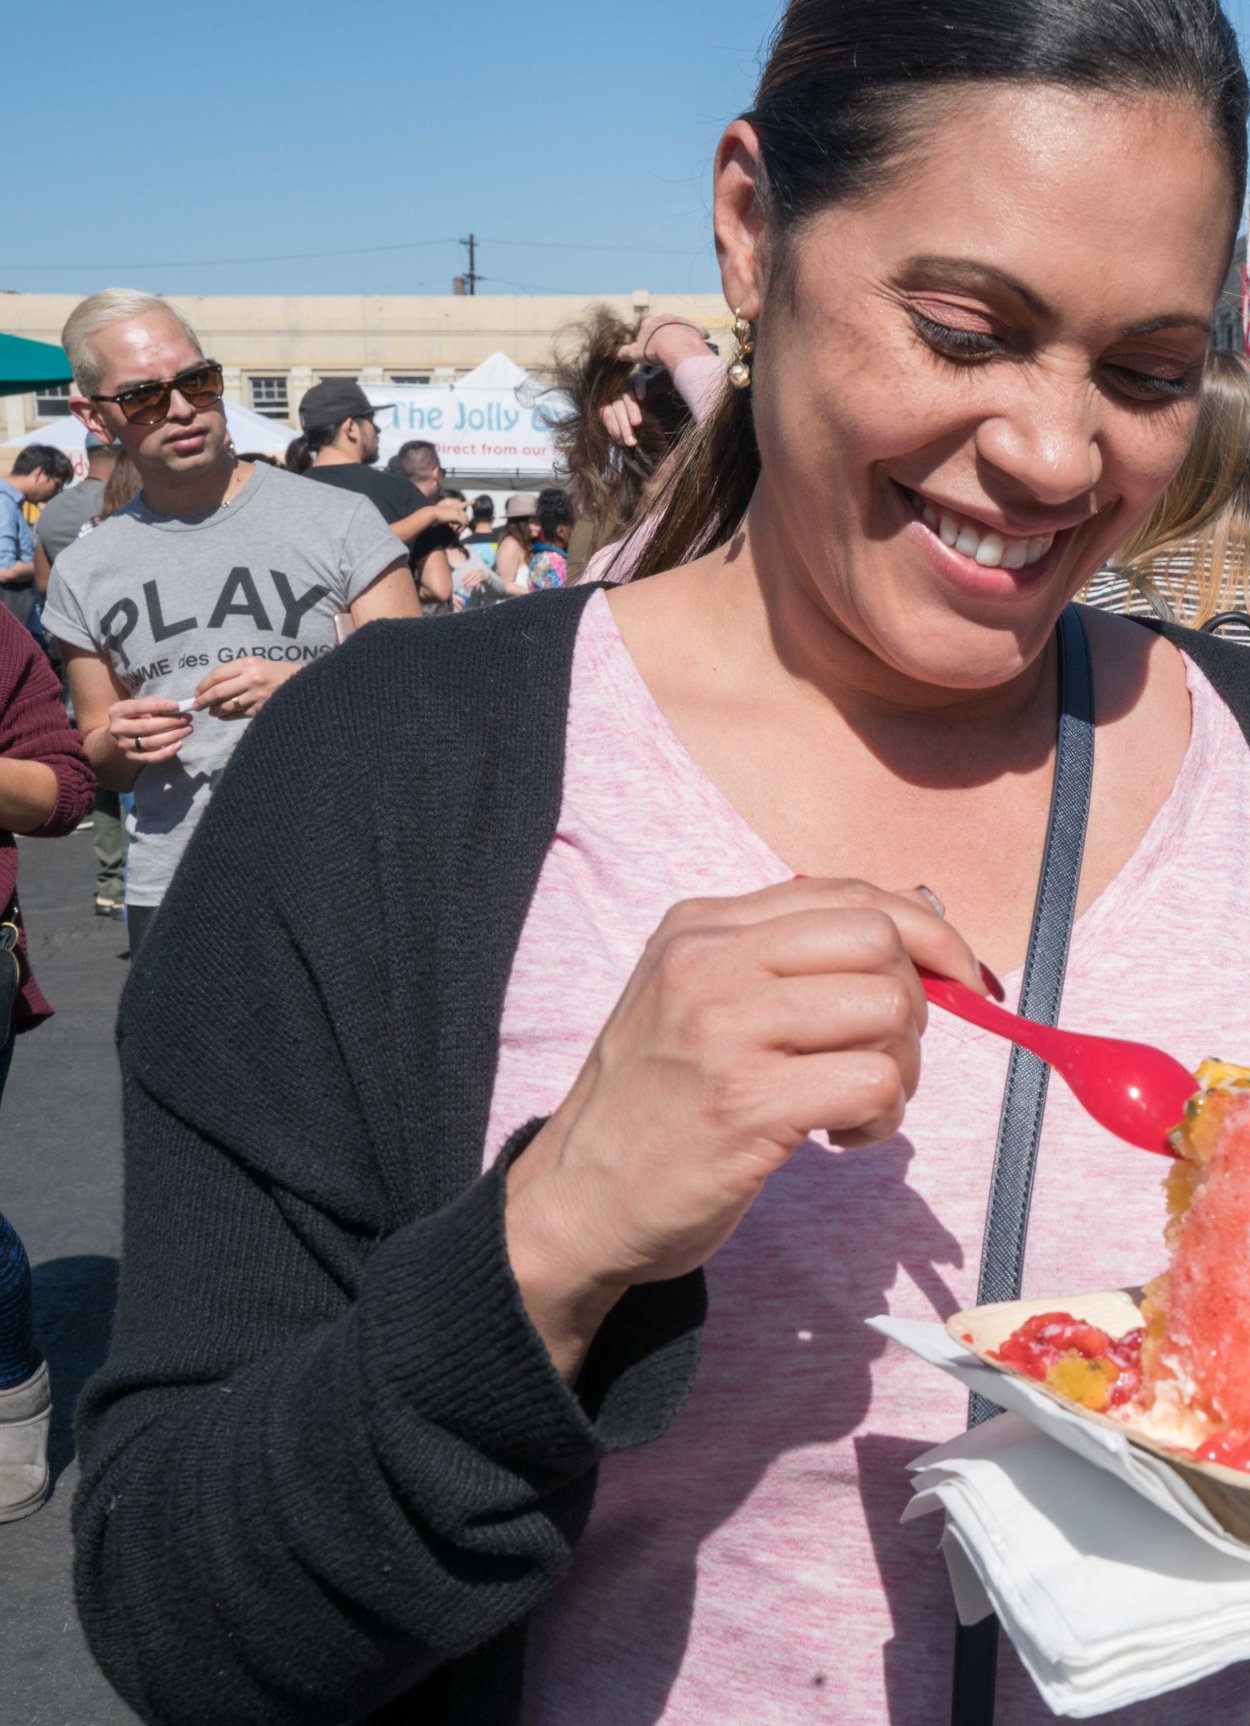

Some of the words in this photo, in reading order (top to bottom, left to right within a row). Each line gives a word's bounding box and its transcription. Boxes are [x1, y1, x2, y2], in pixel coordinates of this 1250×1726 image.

[387, 401, 443, 431] The
[454, 402, 519, 432] Jolly
[481, 443, 517, 456] from
[523, 446, 547, 457] our
[99, 566, 333, 670] PLAY
[177, 652, 209, 670] des
